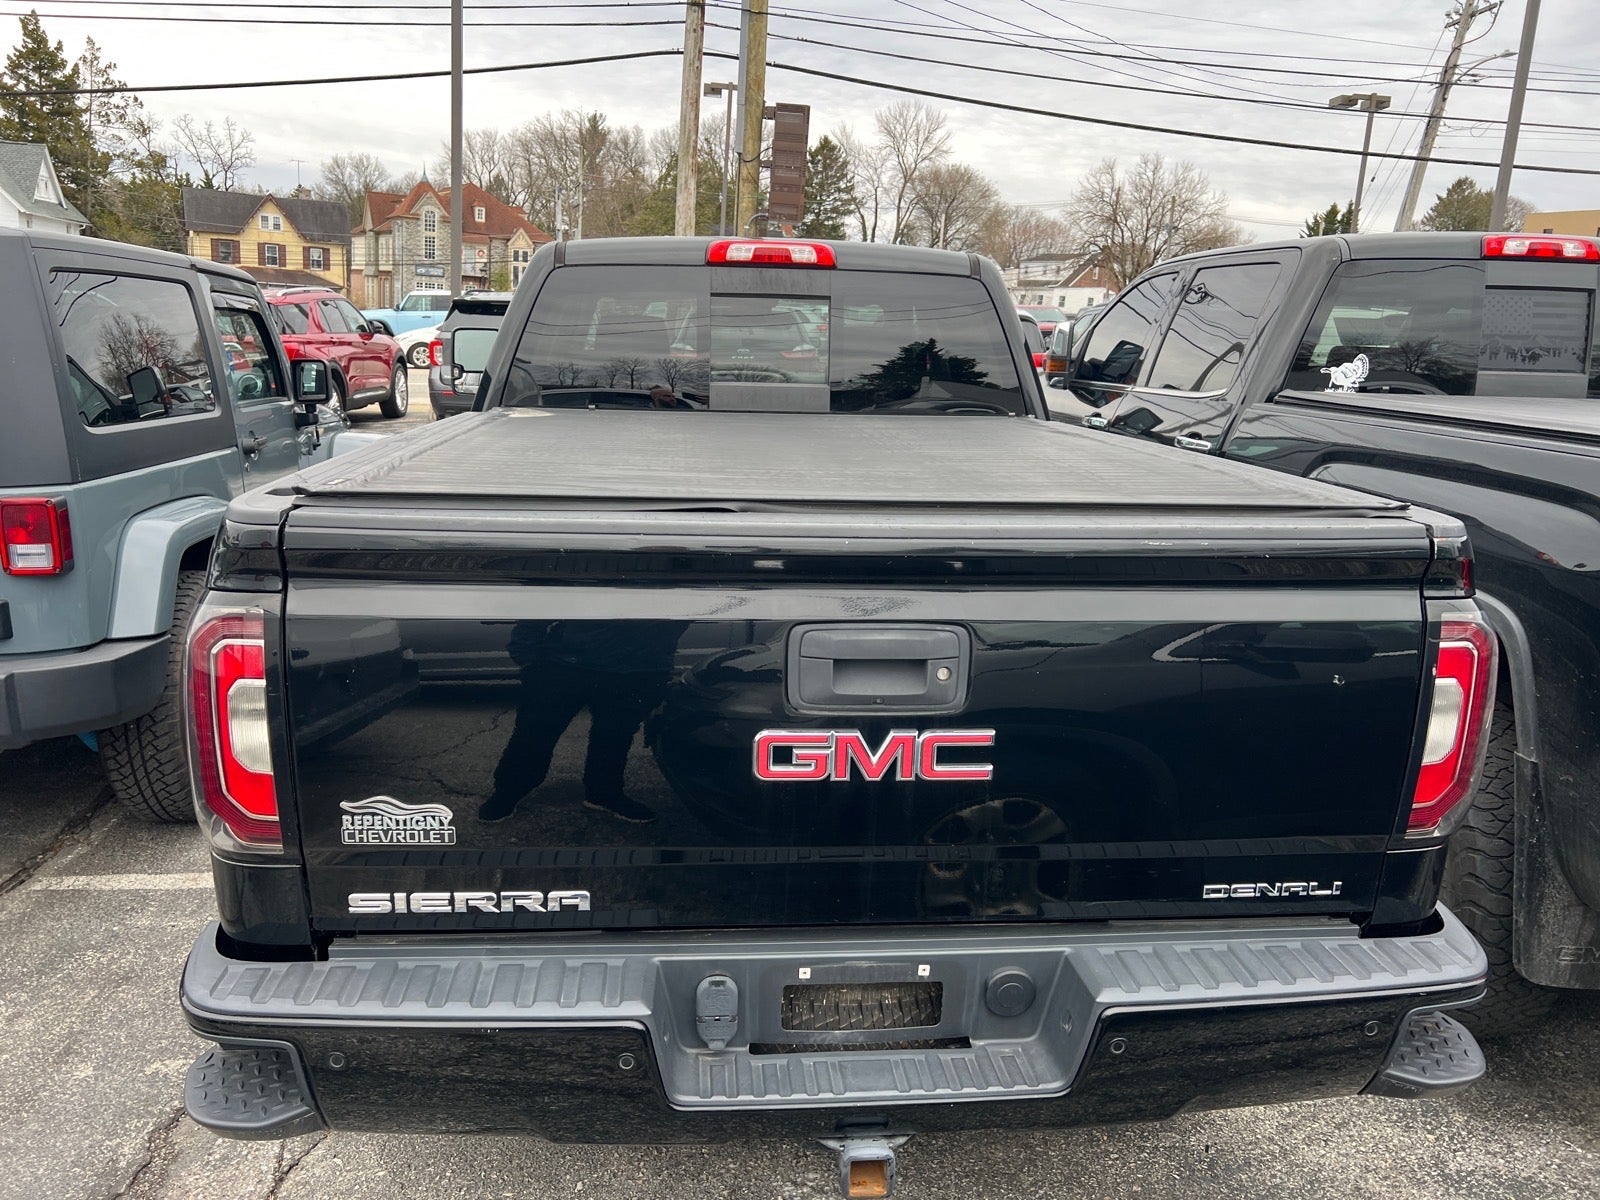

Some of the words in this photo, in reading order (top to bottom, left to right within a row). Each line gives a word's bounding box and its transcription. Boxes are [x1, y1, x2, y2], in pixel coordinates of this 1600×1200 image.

[753, 728, 996, 782] GMC
[341, 814, 453, 830] REPENTIGNY
[343, 830, 453, 843] CHEVROLET
[1202, 881, 1343, 899] DENALI
[347, 890, 591, 914] SIERRA
